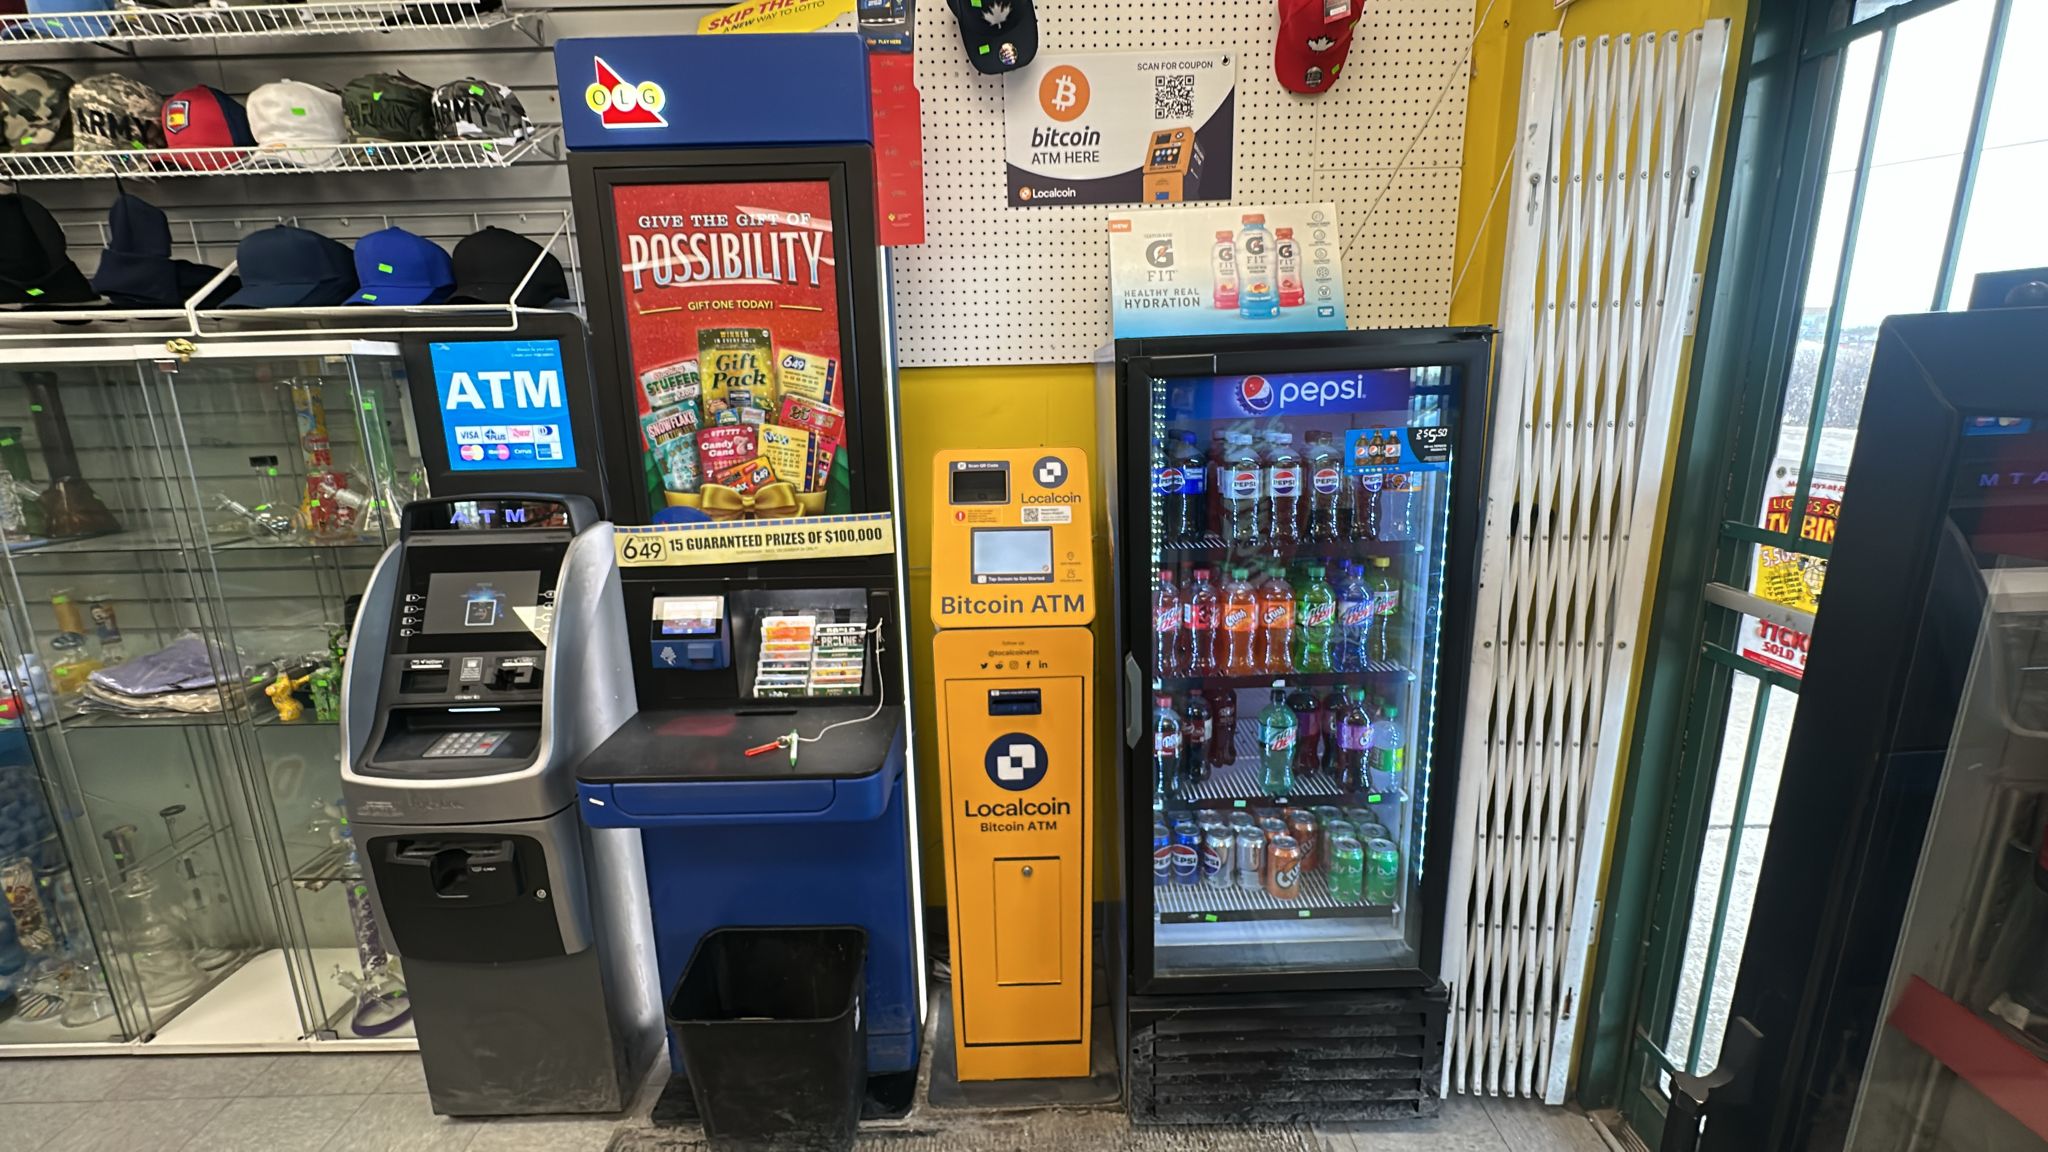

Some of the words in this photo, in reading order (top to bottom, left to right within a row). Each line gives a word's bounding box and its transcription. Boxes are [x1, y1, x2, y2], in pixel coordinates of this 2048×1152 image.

[708, 7, 754, 32] SKIP
[758, 0, 795, 15] THE
[731, 18, 756, 31] NEW
[757, 12, 777, 27] WAY
[779, 8, 794, 17] TO
[794, 0, 826, 14] LOTTO
[1137, 62, 1159, 71] SCAN
[1160, 61, 1177, 71] FOR
[1179, 60, 1213, 70] COUPON
[592, 88, 656, 106] OLG
[1031, 125, 1101, 149] bitcoin
[1031, 151, 1063, 165] ATM
[1065, 150, 1100, 164] HERE
[1032, 187, 1077, 200] Localcoin
[638, 215, 684, 229] GIVE
[691, 214, 729, 227] THE
[736, 213, 780, 227] GIFT
[787, 213, 812, 225] OF
[628, 231, 824, 292] POSSIBILITY
[1146, 239, 1174, 268] G
[1147, 270, 1175, 282] FIT
[1124, 288, 1168, 297] HEALTHY
[1174, 287, 1199, 296] REAL
[688, 301, 711, 312] GIFT
[712, 301, 734, 310] ONE
[736, 300, 774, 310] TODAY!
[1124, 296, 1200, 309] HYDRATION
[716, 352, 757, 371] Gift
[783, 355, 805, 371] 649
[646, 371, 700, 395] STUFFER
[712, 369, 767, 390] Pack
[446, 369, 562, 411] ATM
[1279, 374, 1364, 409] pepsi
[647, 410, 696, 437] SNOWFLAKE
[461, 431, 480, 440] VISA
[490, 432, 507, 441] PLUS
[701, 440, 733, 451] Candy
[708, 448, 735, 457] Cane
[1234, 480, 1257, 488] PEPSI
[1021, 492, 1082, 504] Localcoin
[450, 508, 526, 524] ATM
[623, 537, 662, 560] 649
[669, 538, 684, 552] 15
[686, 534, 763, 551] GUARANTEED
[765, 531, 805, 547] PRIZES
[808, 530, 823, 544] OF
[825, 527, 883, 545] $100,000
[941, 595, 1024, 614] Bitcoin
[1031, 594, 1085, 613] ATM
[1225, 608, 1248, 627] Crush
[1264, 605, 1286, 624] Crush
[820, 635, 858, 647] PROLINE
[1763, 641, 1795, 661] SOLD
[964, 797, 1071, 818] Localcoin
[980, 822, 1024, 833] Bitcoin
[1027, 821, 1057, 832] ATM
